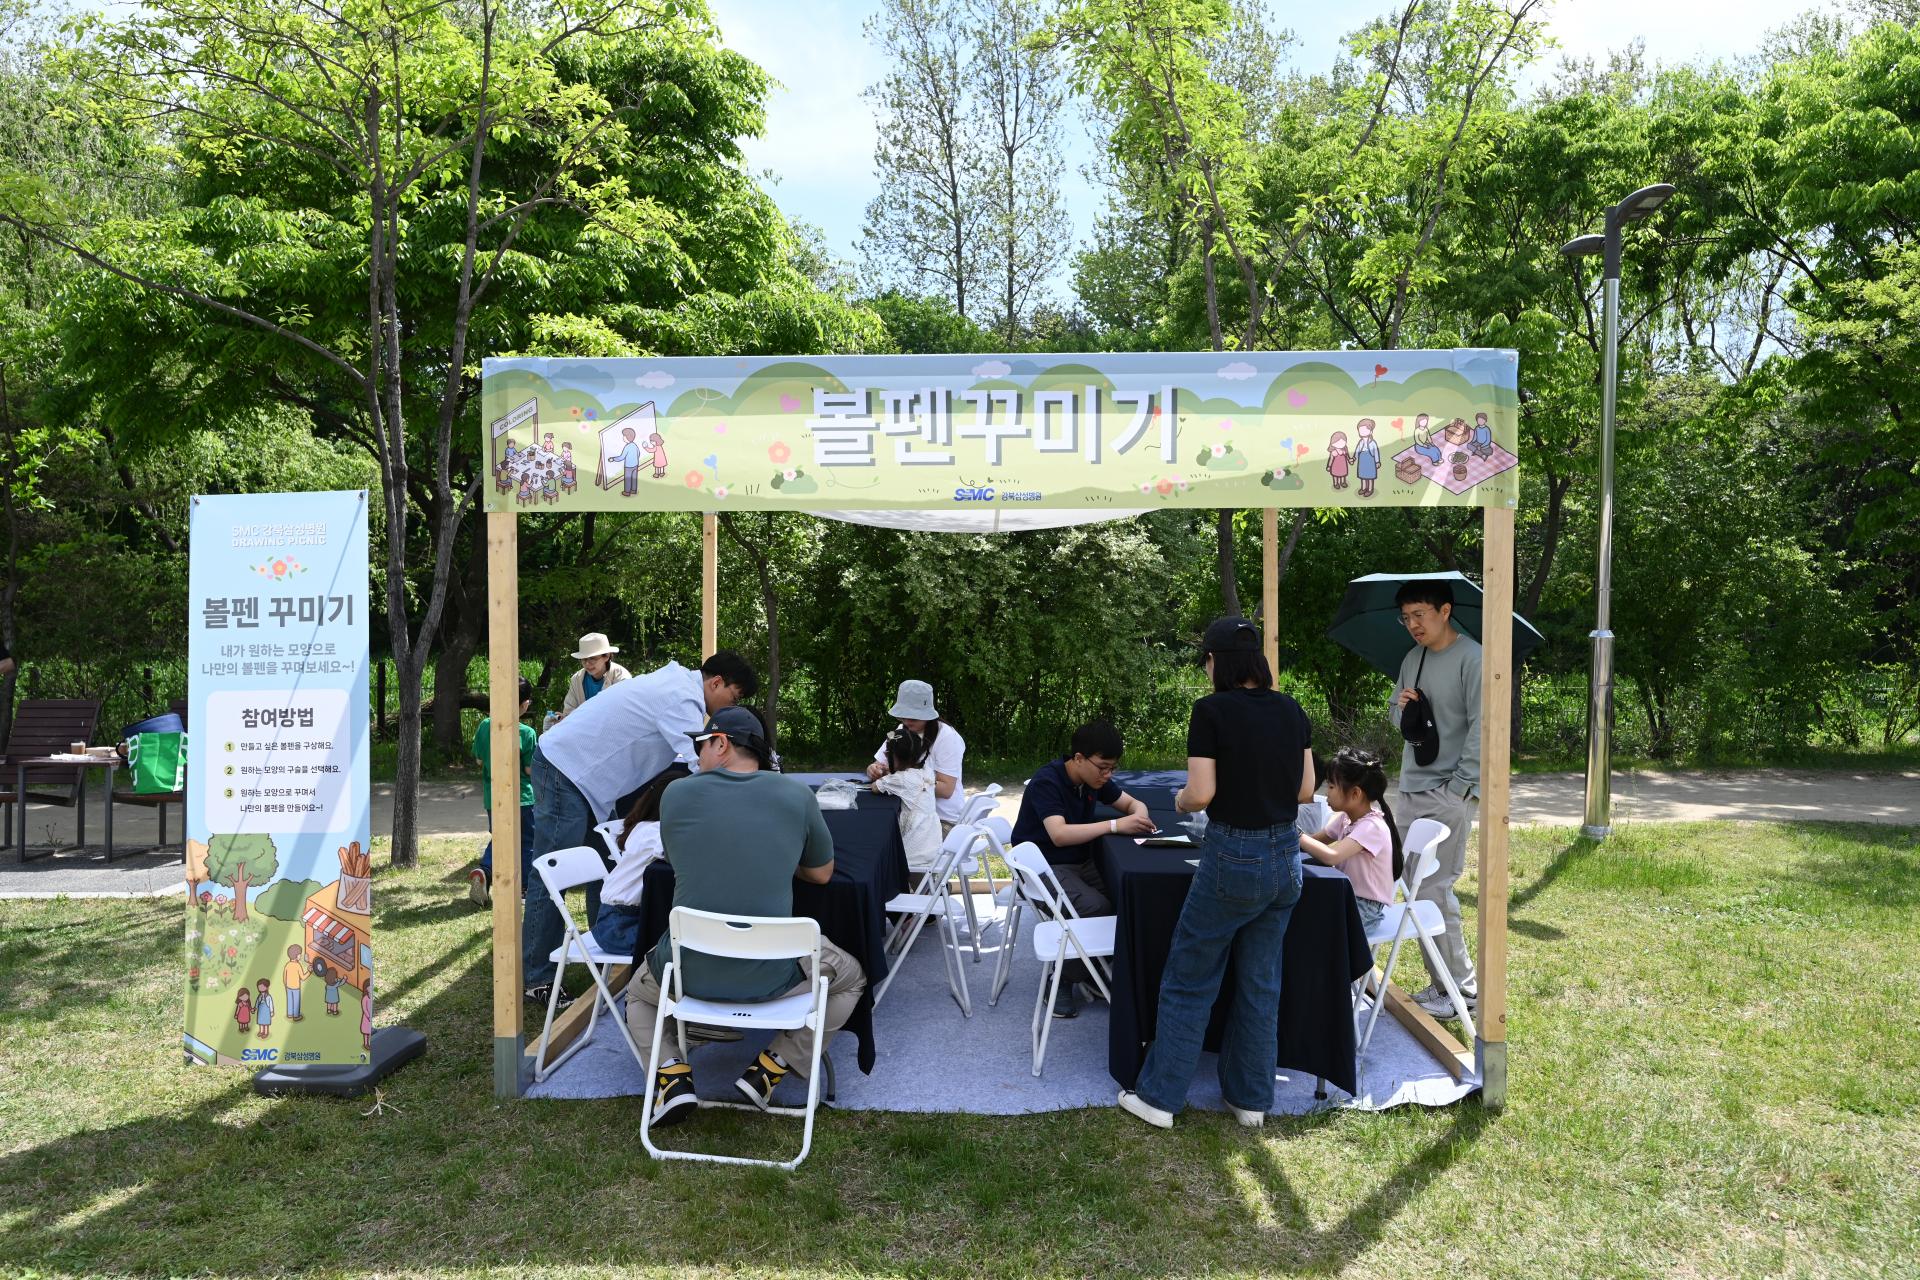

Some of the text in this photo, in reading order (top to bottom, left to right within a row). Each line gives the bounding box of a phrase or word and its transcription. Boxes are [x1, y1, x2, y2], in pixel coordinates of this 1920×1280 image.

[499, 406, 534, 431] COLORING
[805, 385, 1178, 466] 볼펜꾸미기
[953, 488, 995, 502] SMC
[232, 526, 260, 538] SMC
[232, 536, 327, 548] DRAWING PICNIC
[202, 594, 353, 629] 볼펜 꾸미기
[221, 643, 336, 658] 내가 원하는 모양으로
[202, 660, 355, 676] 나만의 볼펜을 꾸며보세요~!
[241, 707, 314, 729] 참여방법
[240, 742, 262, 751] 만들고
[264, 742, 279, 751] 싶은
[280, 741, 301, 751] 볼펜을
[303, 741, 334, 751] 구상해요.
[240, 766, 262, 775] 원하는
[264, 765, 286, 775] 모양의
[310, 765, 342, 774] 선택해요.
[240, 788, 262, 798] 원하는
[264, 788, 293, 797] 모양으로
[294, 788, 316, 797] 꾸며서
[240, 803, 324, 813] 나만의 볼펜을 만들어요~!
[241, 1048, 278, 1061] SMC
